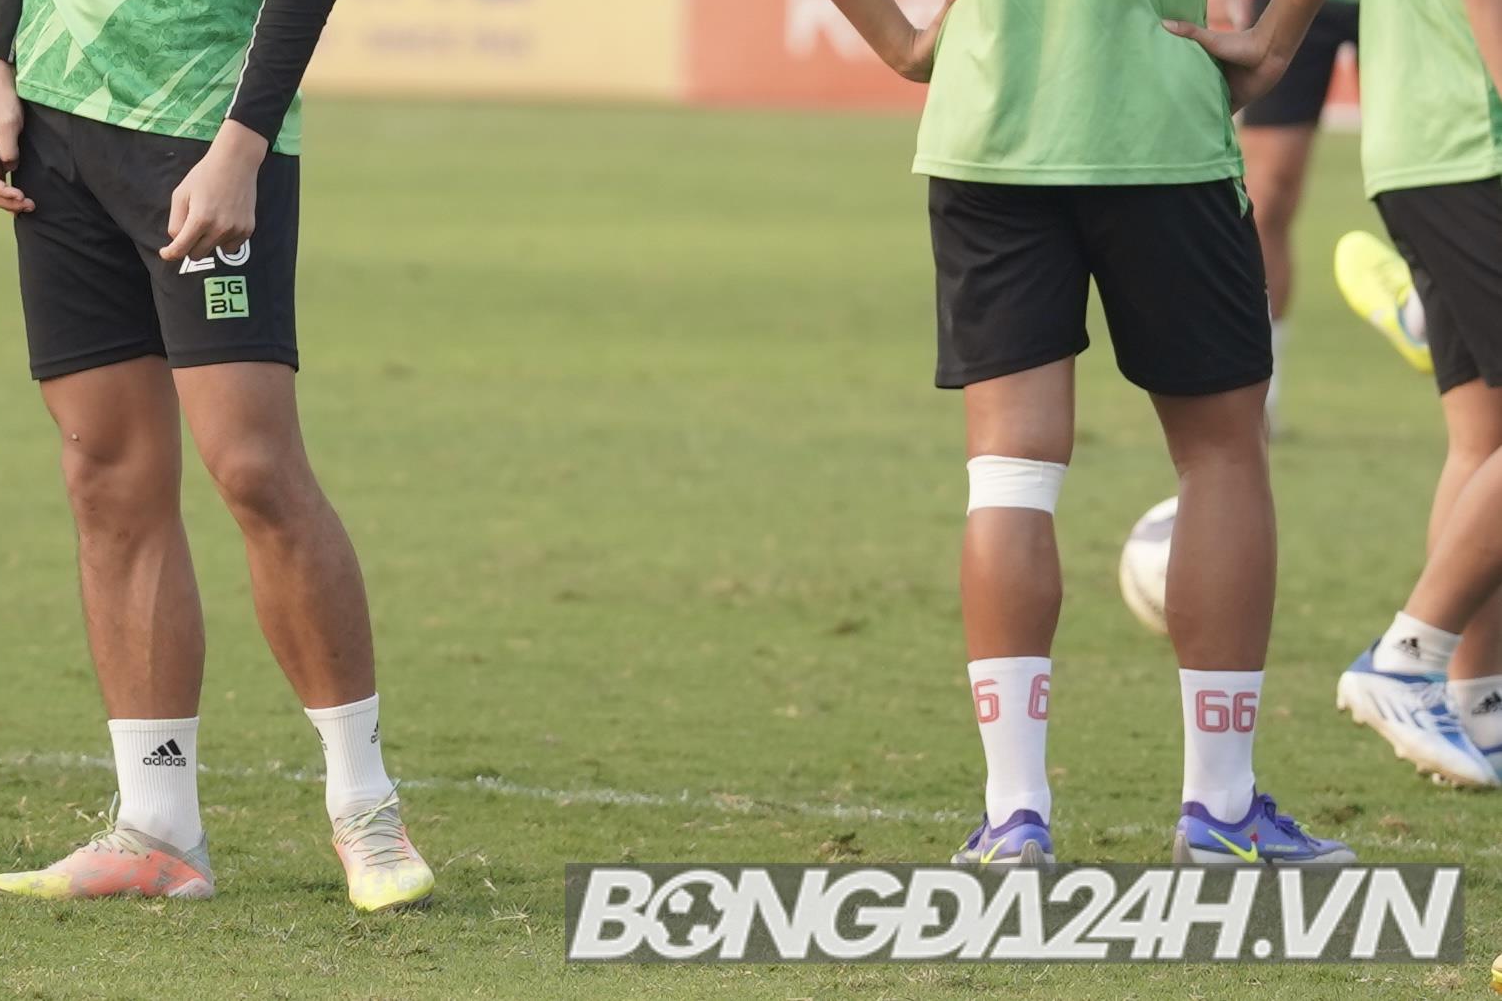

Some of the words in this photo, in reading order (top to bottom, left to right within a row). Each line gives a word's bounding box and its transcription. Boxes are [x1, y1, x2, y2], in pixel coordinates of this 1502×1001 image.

[210, 280, 243, 297] JG
[210, 298, 245, 314] BL
[1195, 689, 1257, 733] 66
[142, 755, 187, 767] adidas
